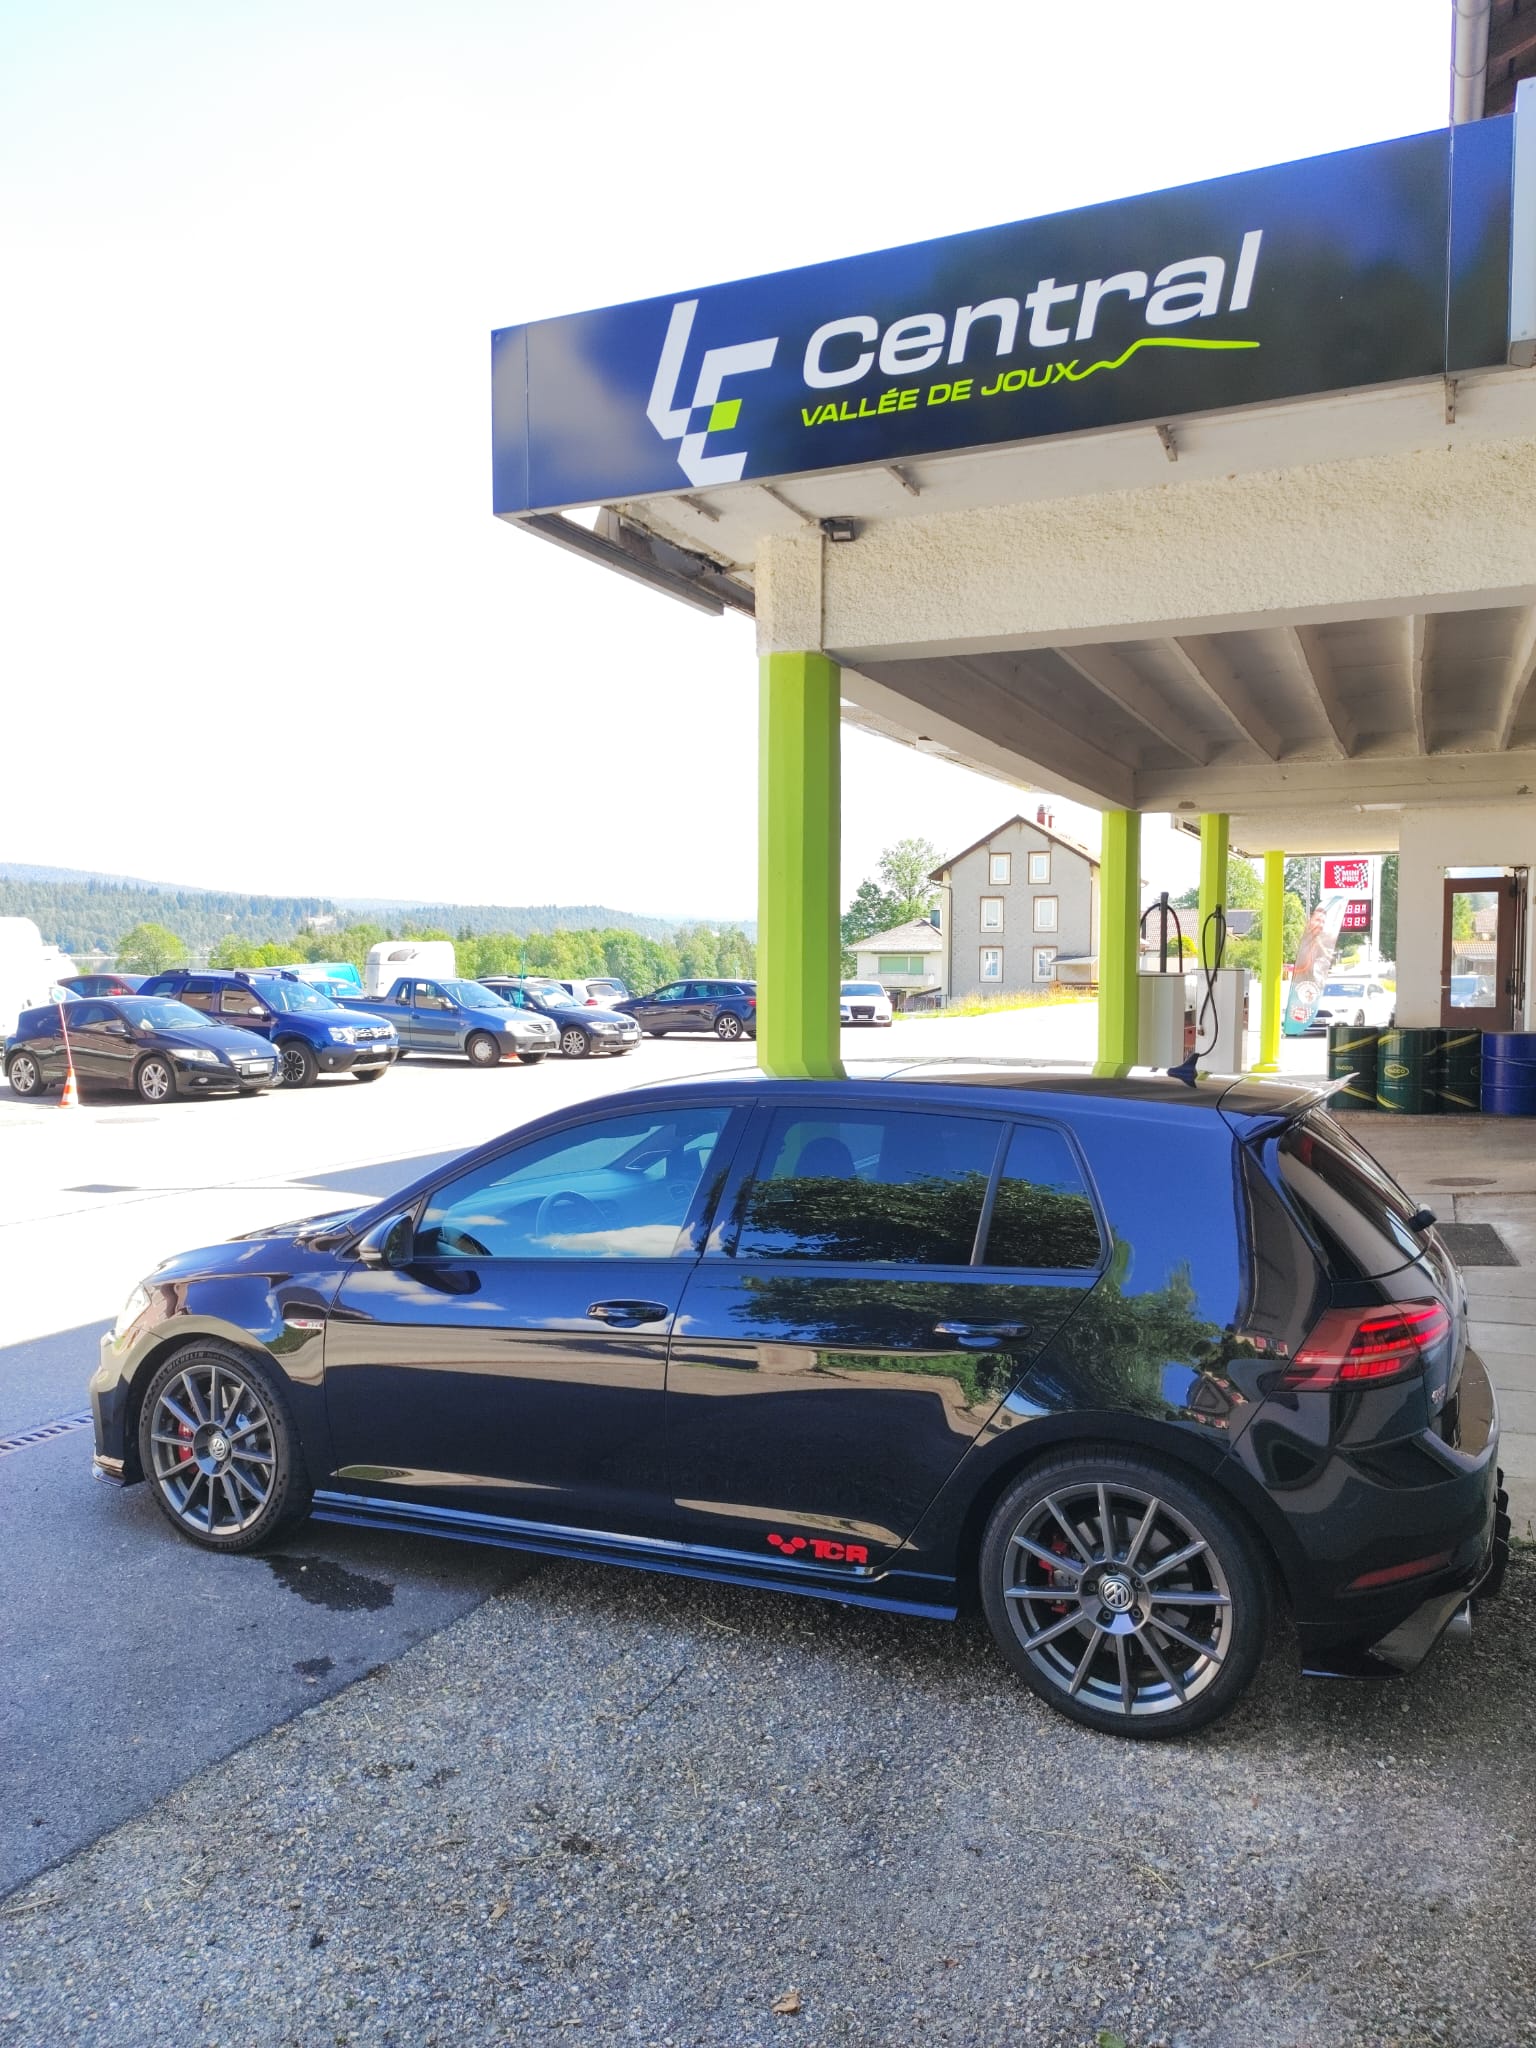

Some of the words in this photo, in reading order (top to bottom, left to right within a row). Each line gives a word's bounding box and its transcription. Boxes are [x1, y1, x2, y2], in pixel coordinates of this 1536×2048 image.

[803, 230, 1263, 389] Central
[801, 388, 920, 427] VALLÉE
[927, 379, 974, 406] DE
[981, 360, 1080, 396] JOUX
[808, 1539, 868, 1564] TCR
